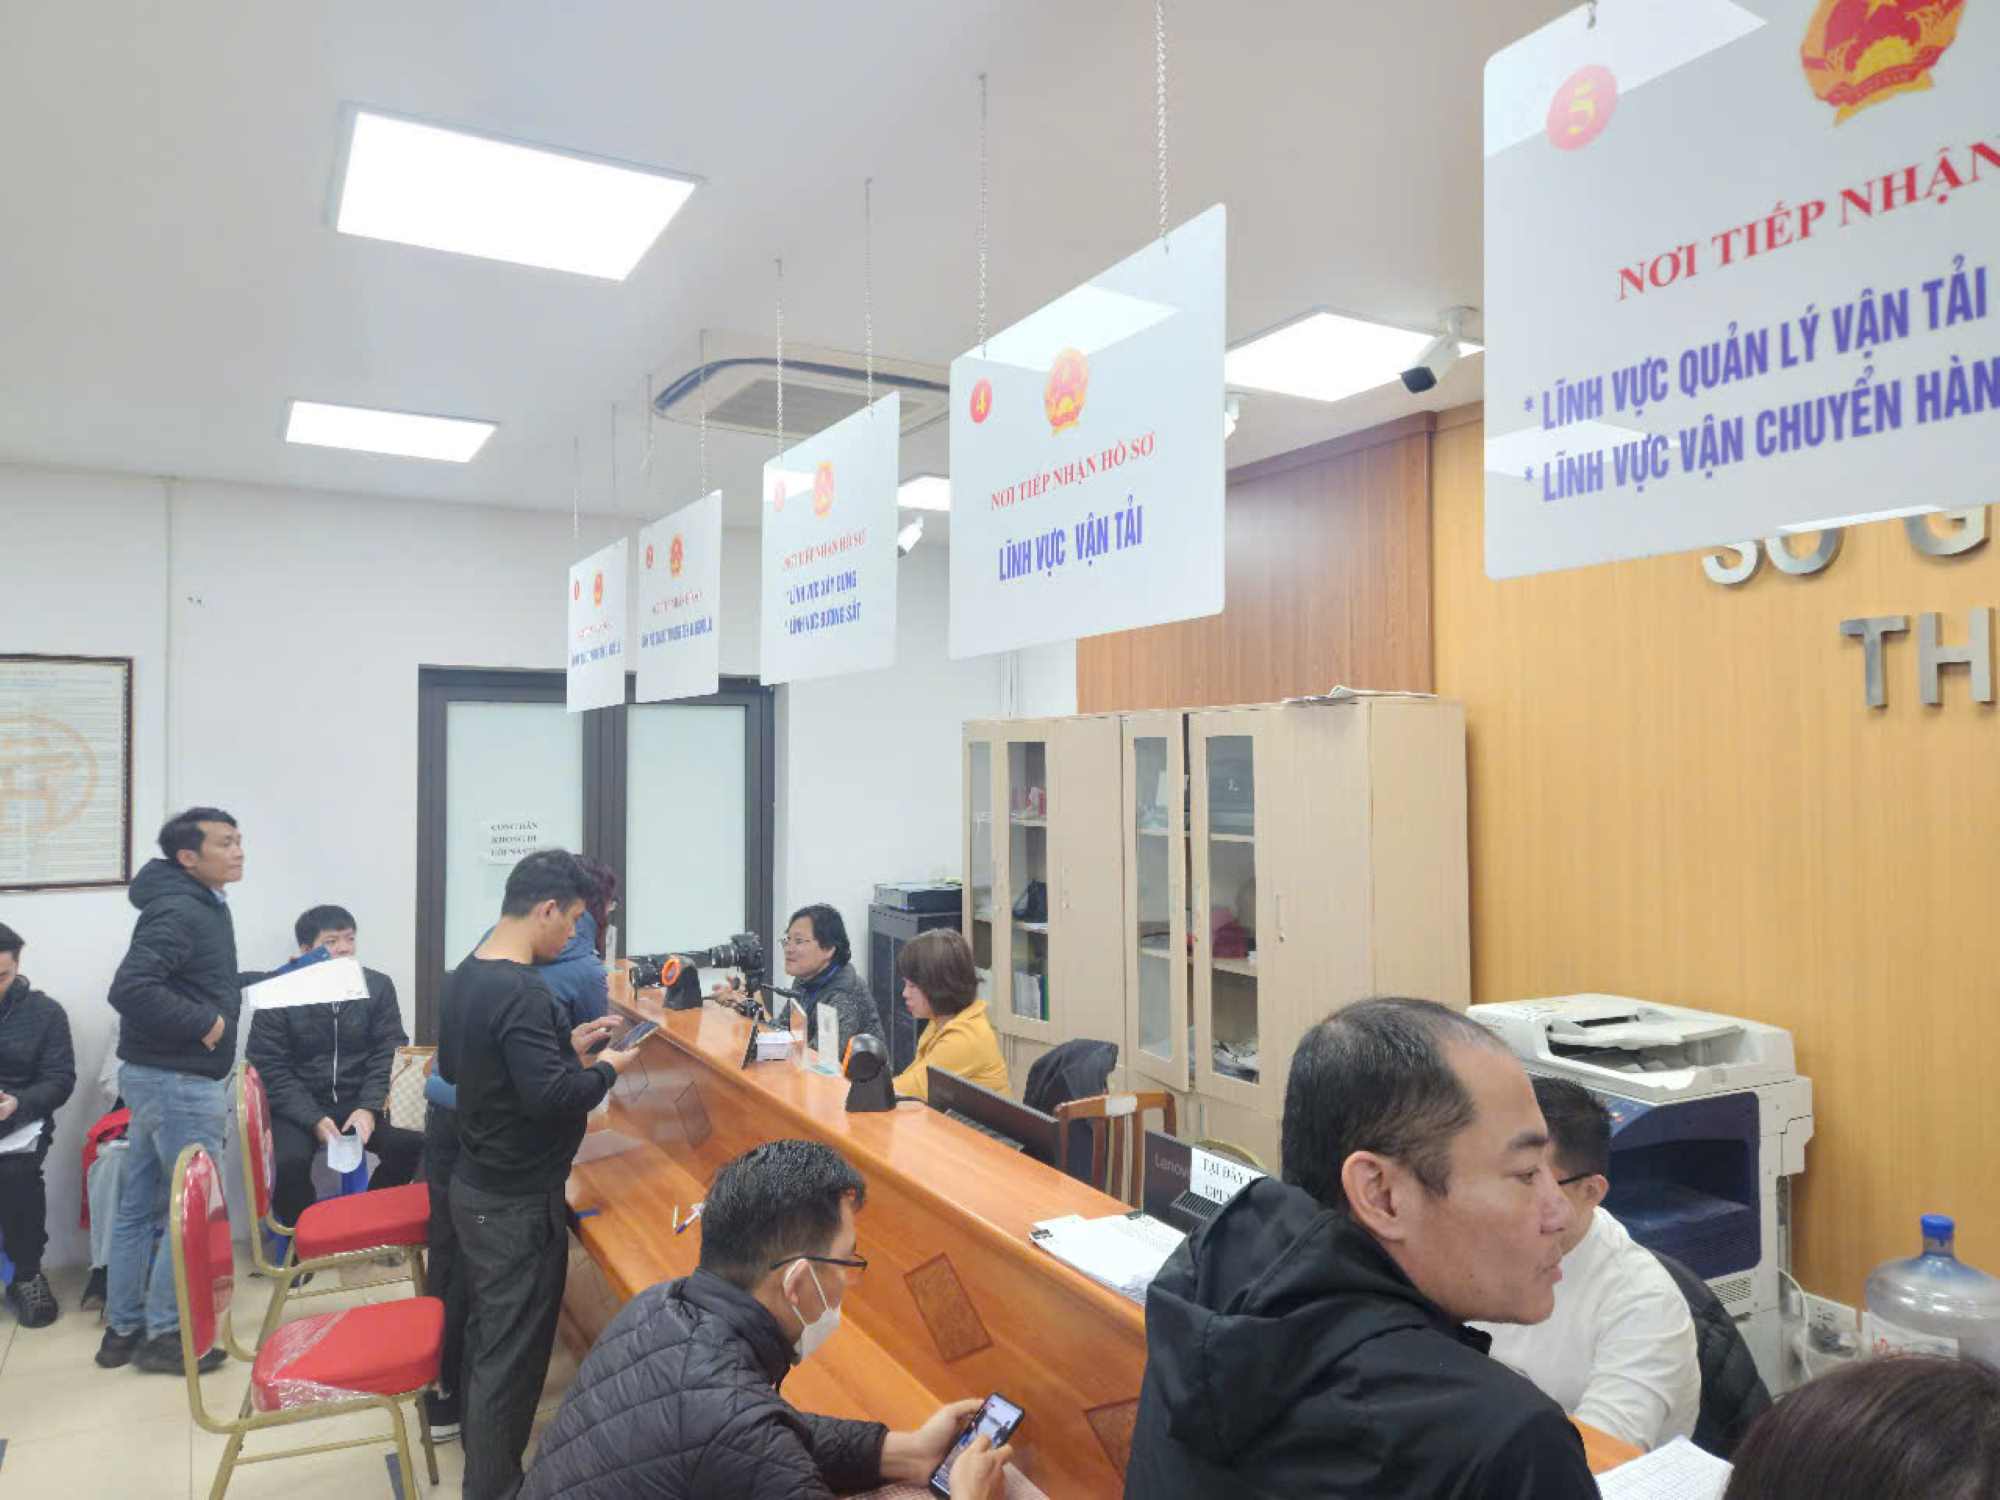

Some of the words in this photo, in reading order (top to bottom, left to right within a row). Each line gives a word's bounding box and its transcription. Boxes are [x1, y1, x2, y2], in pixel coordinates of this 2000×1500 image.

[1567, 79, 1599, 136] 5
[1616, 241, 1698, 302] NƠI
[1711, 199, 1826, 268] TIẾP
[1542, 376, 1603, 431] LĨNH
[1612, 356, 1669, 417] VỰC
[1679, 321, 1769, 398] QUẢN
[1780, 303, 1821, 369] LÝ
[1832, 286, 1910, 359] VẬN
[1922, 253, 1987, 331] TẢI
[991, 486, 1015, 511] NƠI
[1018, 471, 1051, 502] TIẾP
[1053, 454, 1097, 488] NHẬN
[1100, 439, 1127, 471] HỒ
[1130, 430, 1156, 459] SƠ
[1543, 448, 1604, 502] LĨNH
[1612, 432, 1669, 493] VỰC
[1679, 413, 1744, 479] VẬN
[1755, 364, 1902, 458] CHUYỂN
[999, 539, 1032, 582] LĨNH
[1035, 527, 1065, 577] VỰC
[1075, 511, 1109, 567] VẬN
[1114, 494, 1143, 551] TẢI
